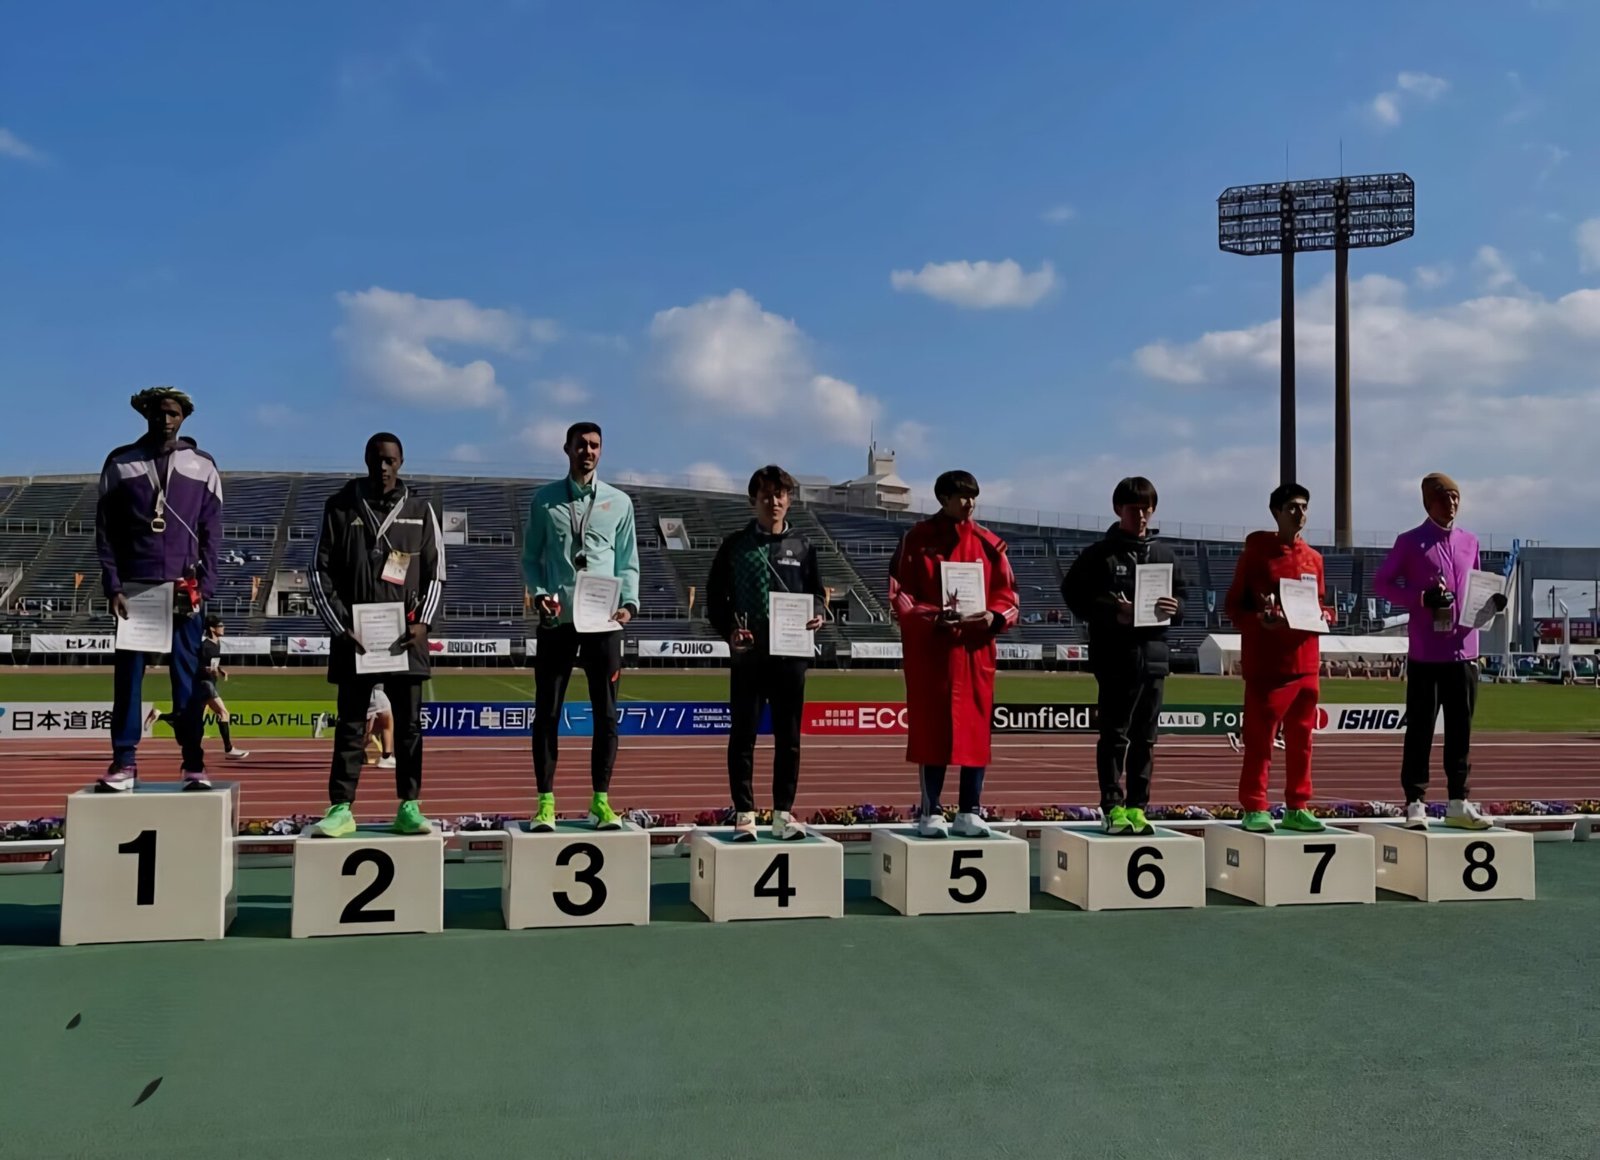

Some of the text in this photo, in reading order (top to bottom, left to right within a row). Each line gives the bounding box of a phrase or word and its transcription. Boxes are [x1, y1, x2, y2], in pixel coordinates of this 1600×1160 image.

[672, 642, 713, 654] FUJIKO
[12, 709, 113, 731] 日本道路
[203, 713, 263, 726] WRLD
[993, 706, 1090, 729] Sunfield
[118, 829, 157, 906] 1
[339, 847, 396, 924] 2
[552, 842, 607, 917] 3
[753, 853, 797, 908] 4
[947, 849, 988, 904] 5
[1126, 846, 1166, 899] 6
[1303, 843, 1337, 894] 7
[1462, 841, 1498, 892] 8
